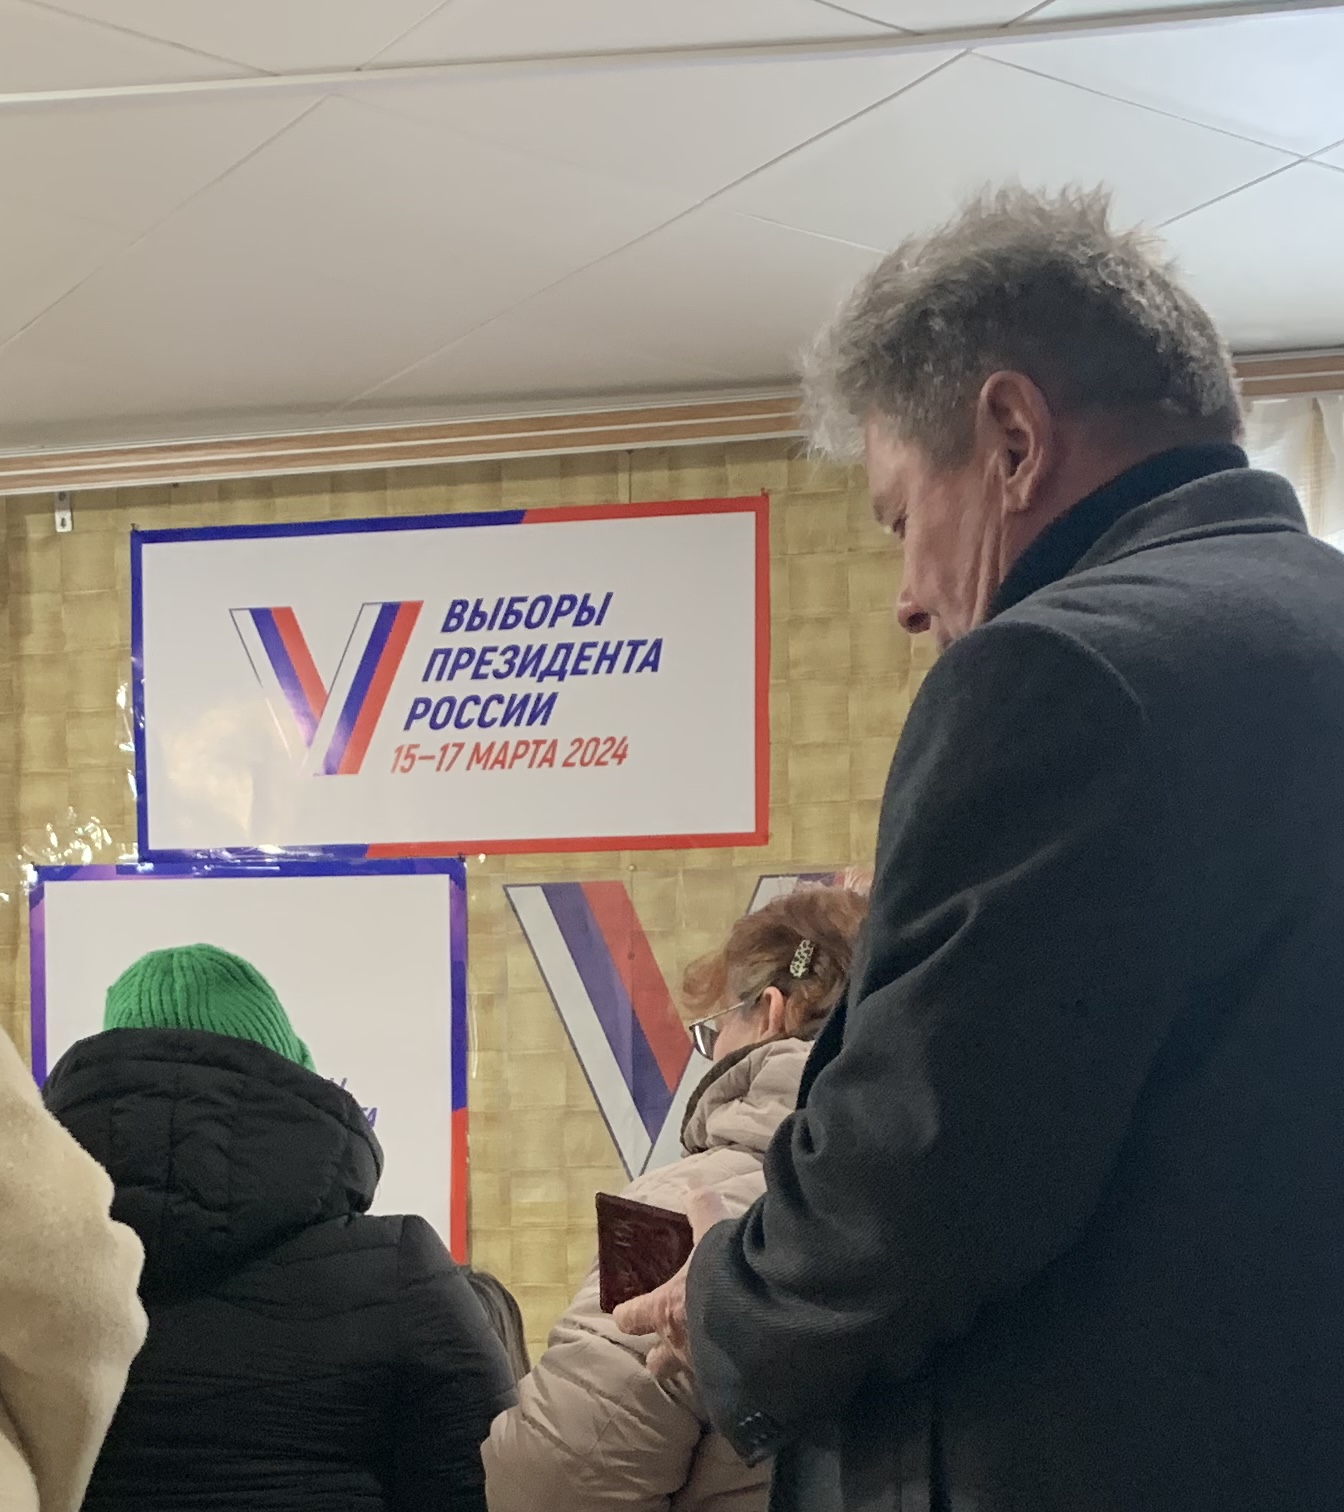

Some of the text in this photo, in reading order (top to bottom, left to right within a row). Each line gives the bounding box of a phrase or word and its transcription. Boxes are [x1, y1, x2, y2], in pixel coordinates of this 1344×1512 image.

[440, 592, 614, 633] ВЫБОРЫ
[421, 638, 664, 683] ПРЕЗИДЕНТА
[403, 691, 560, 731] РОССИИ
[465, 738, 559, 771] МАРТА
[561, 736, 629, 768] 2024
